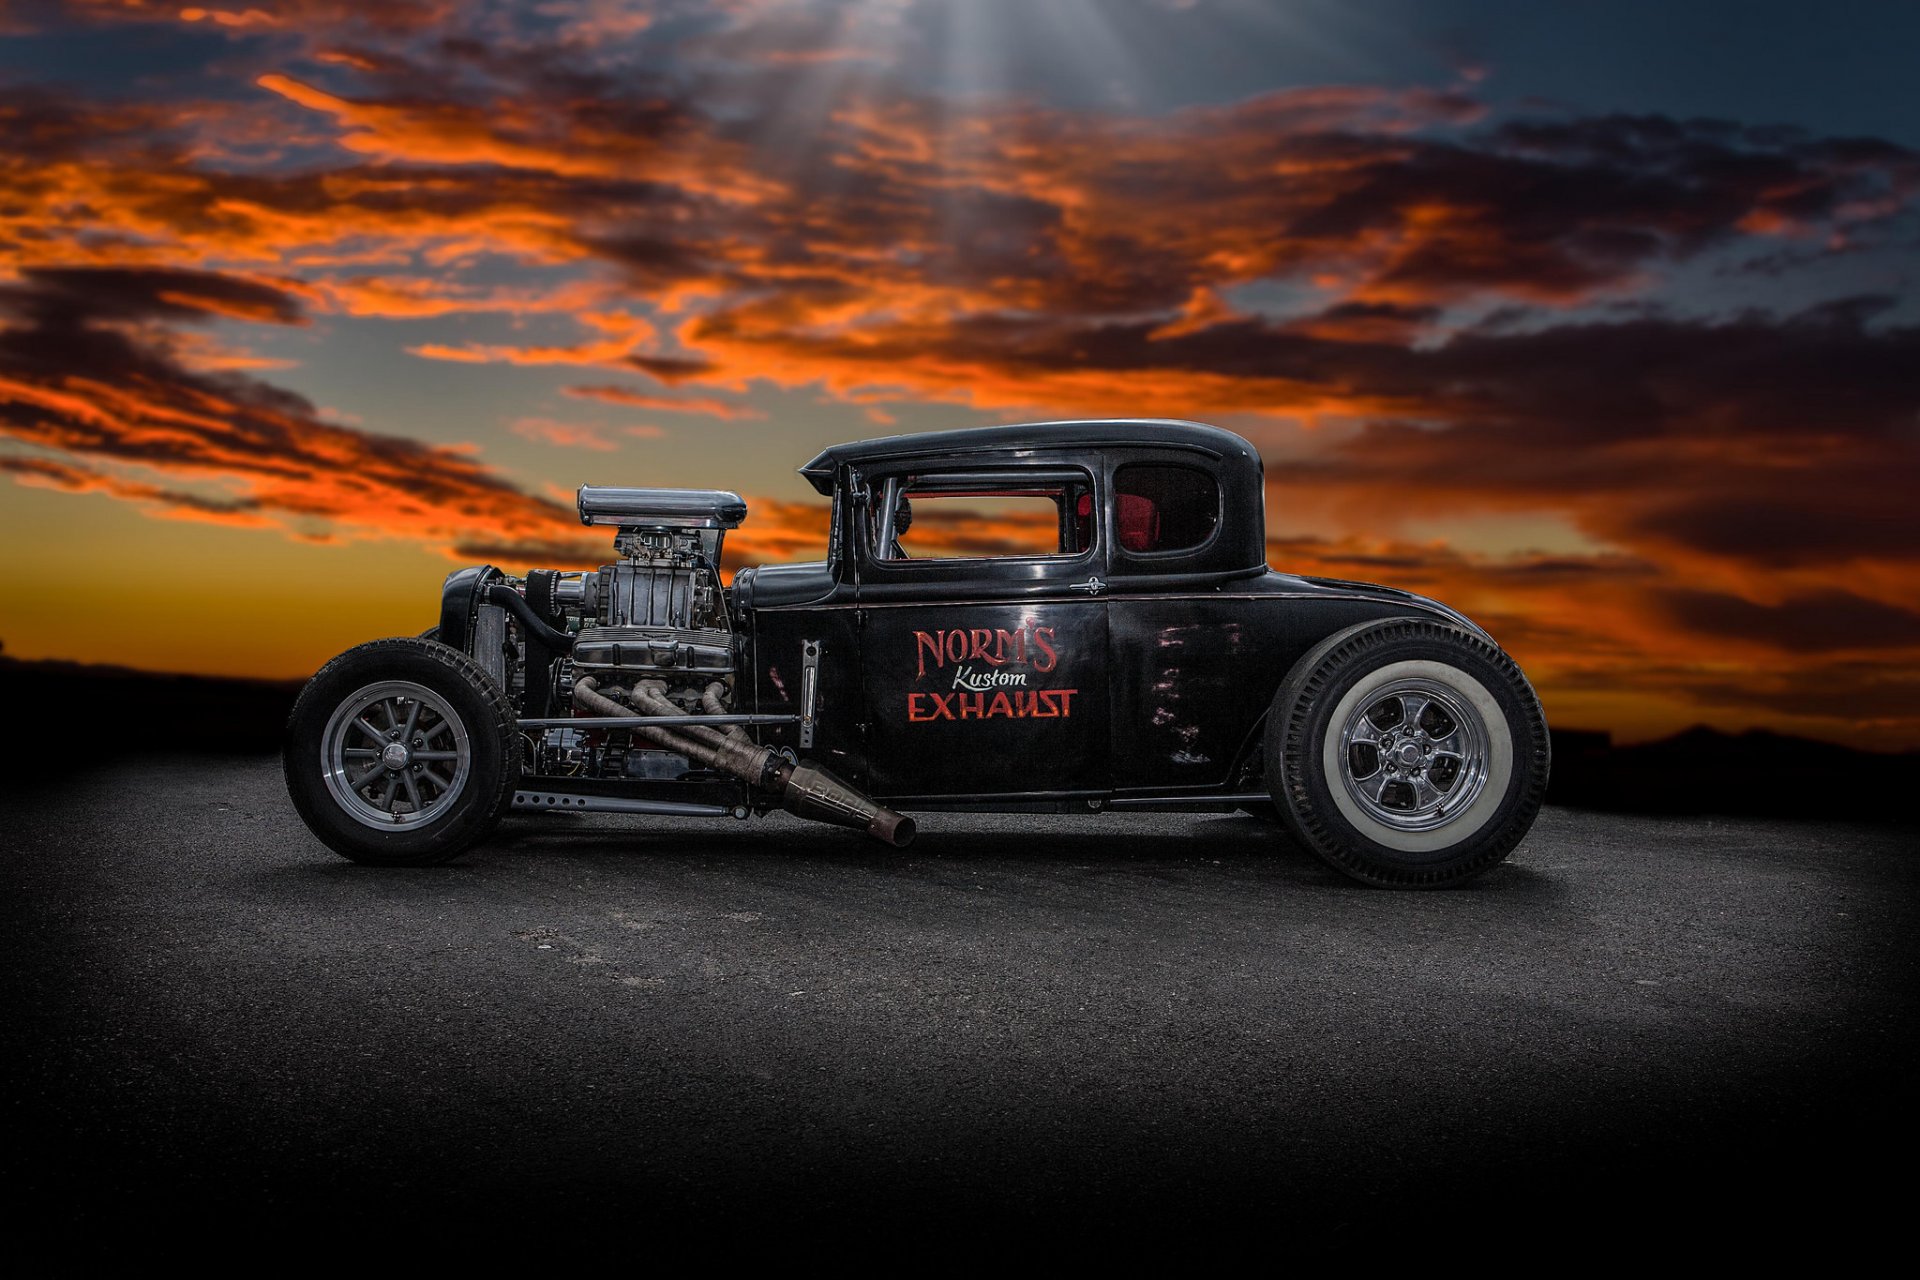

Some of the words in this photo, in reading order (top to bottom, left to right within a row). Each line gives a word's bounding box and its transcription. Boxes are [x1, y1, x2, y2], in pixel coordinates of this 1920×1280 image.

[912, 617, 1057, 683] NORM'S
[952, 665, 1027, 691] Kustom
[907, 689, 1078, 722] EXHAUST
